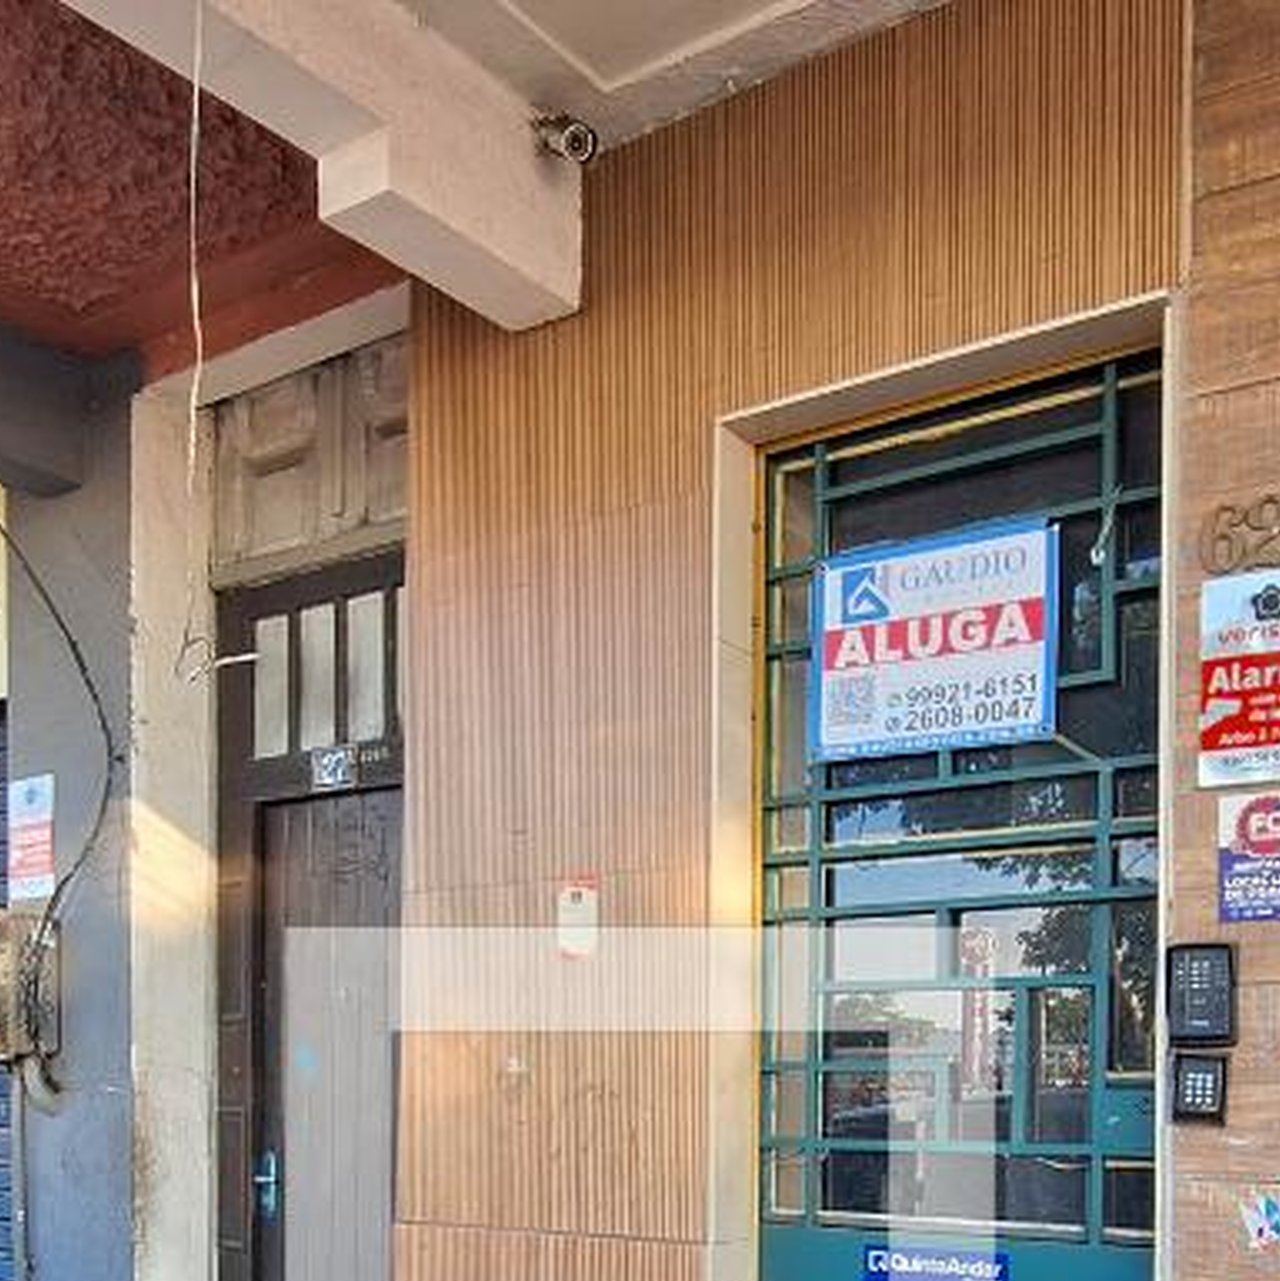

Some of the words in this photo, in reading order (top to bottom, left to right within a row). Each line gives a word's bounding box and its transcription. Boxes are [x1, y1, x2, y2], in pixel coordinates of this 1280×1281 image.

[900, 546, 1028, 592] GAUDIO
[833, 602, 1033, 670] ALUGA
[904, 672, 1039, 710] 99921-6151
[902, 695, 1038, 733] 2608-0047
[890, 1252, 1003, 1278] QuintoAndar
